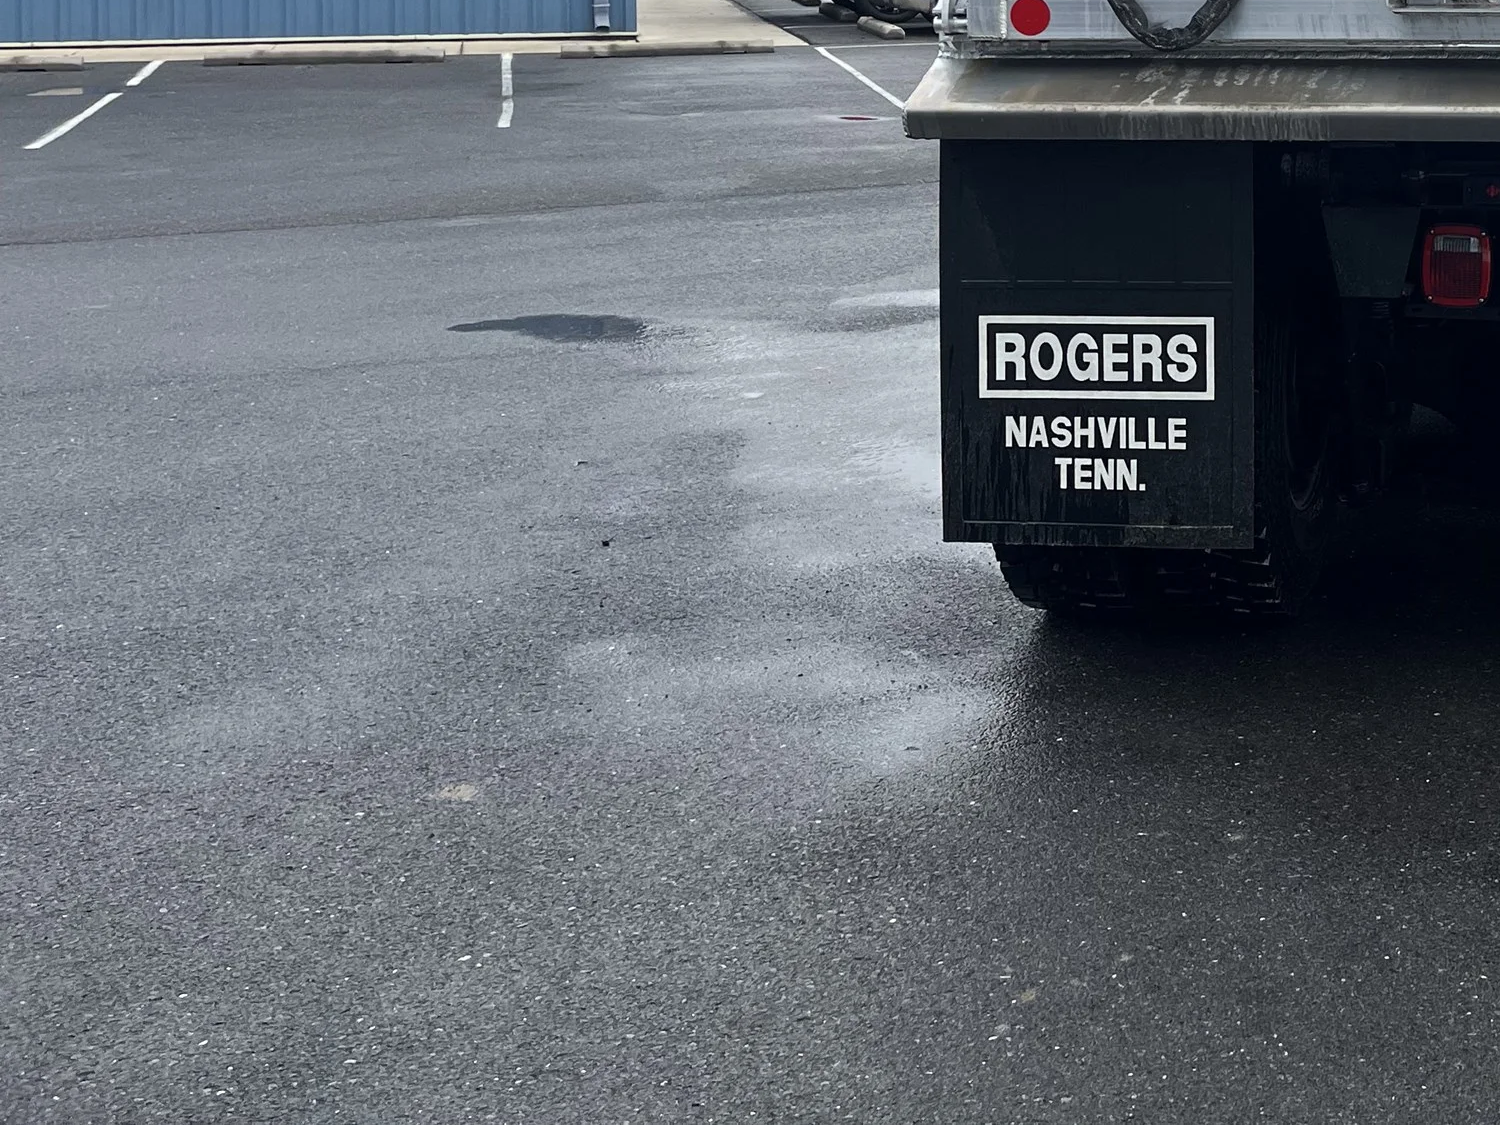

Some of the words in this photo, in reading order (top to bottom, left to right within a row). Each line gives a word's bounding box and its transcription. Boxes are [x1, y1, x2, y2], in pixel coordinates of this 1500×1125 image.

[995, 331, 1199, 383] ROGERS
[1005, 415, 1187, 450] NASHVILLE
[1054, 457, 1147, 492] TENN.
